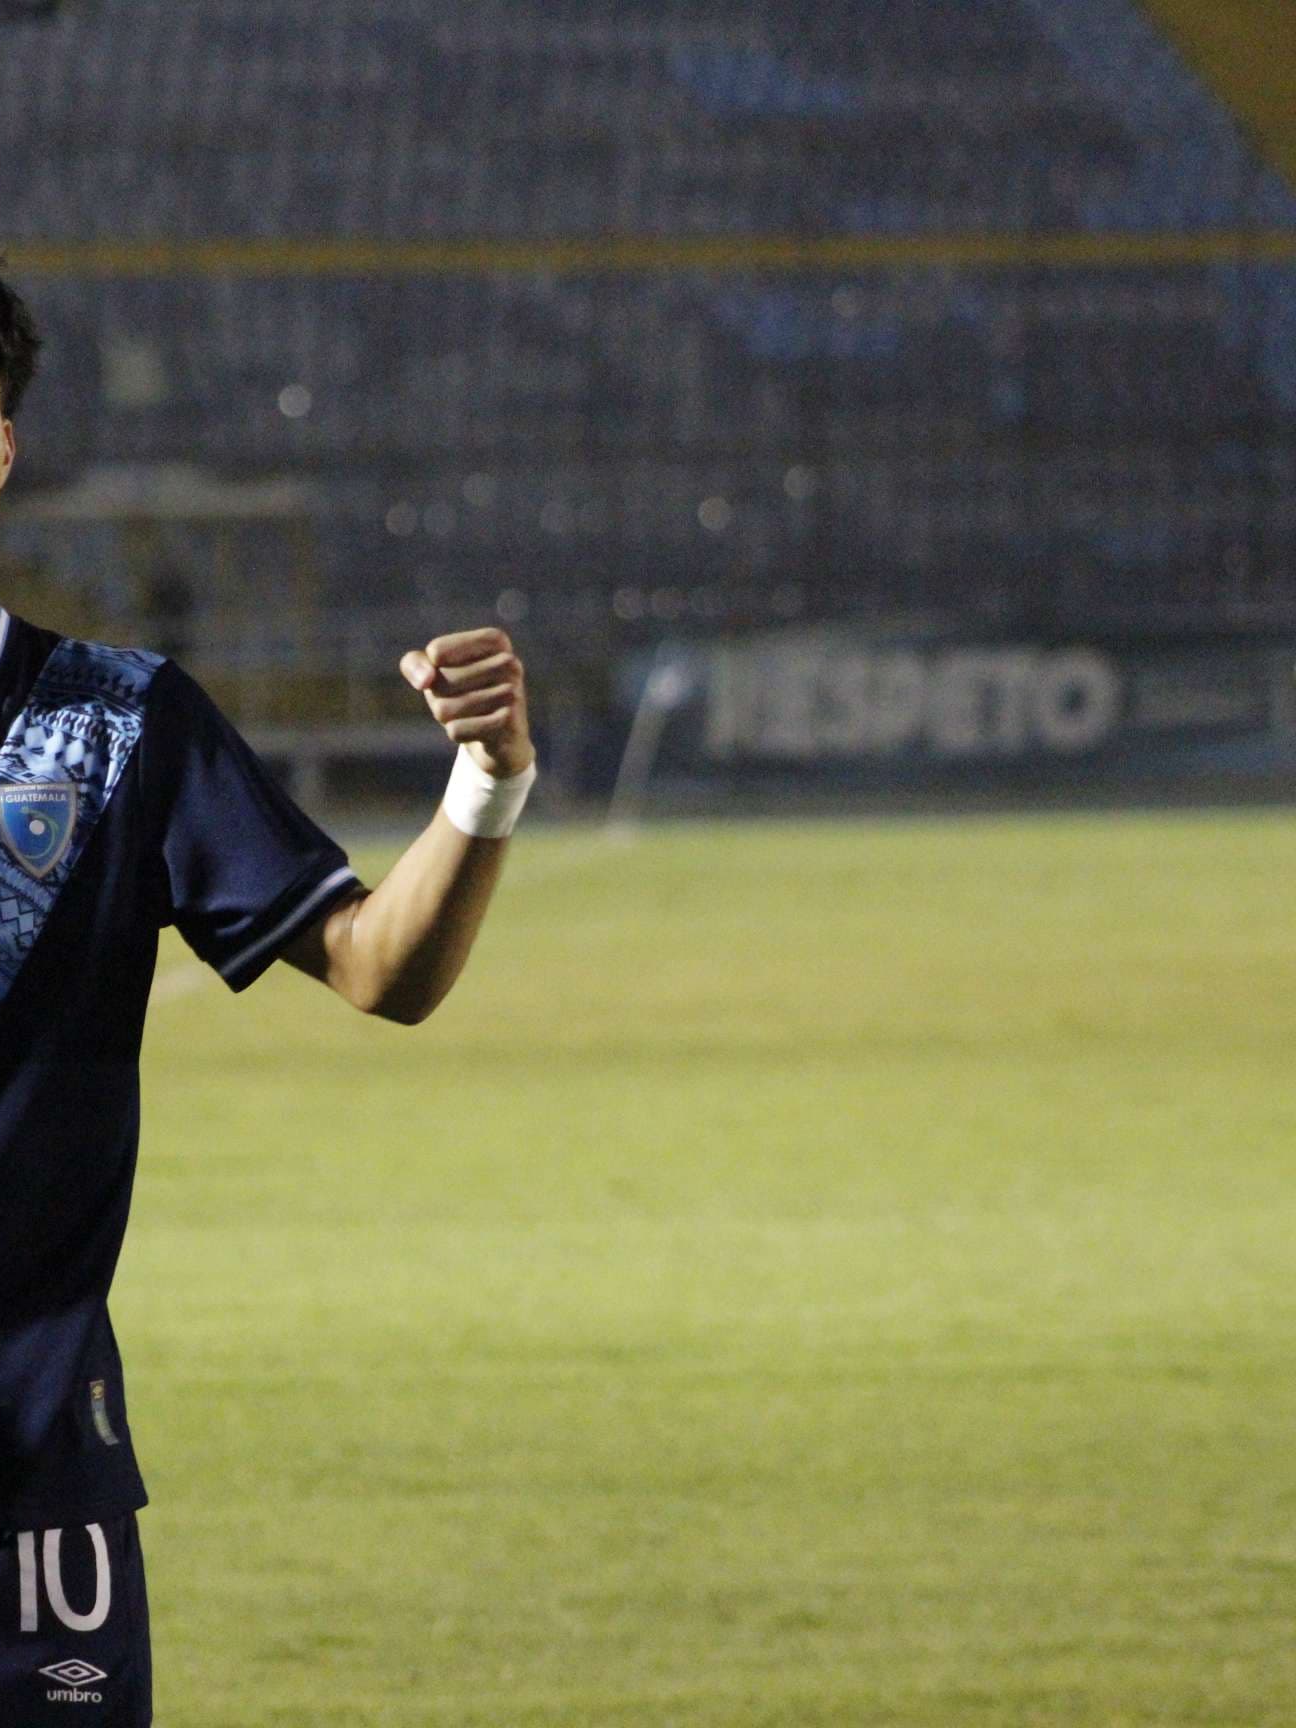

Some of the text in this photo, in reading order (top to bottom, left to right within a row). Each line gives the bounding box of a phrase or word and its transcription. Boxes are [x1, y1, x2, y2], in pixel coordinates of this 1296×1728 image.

[5, 793, 67, 803] GUATEMALA
[17, 1523, 112, 1633] 10
[47, 1688, 103, 1704] umbro
